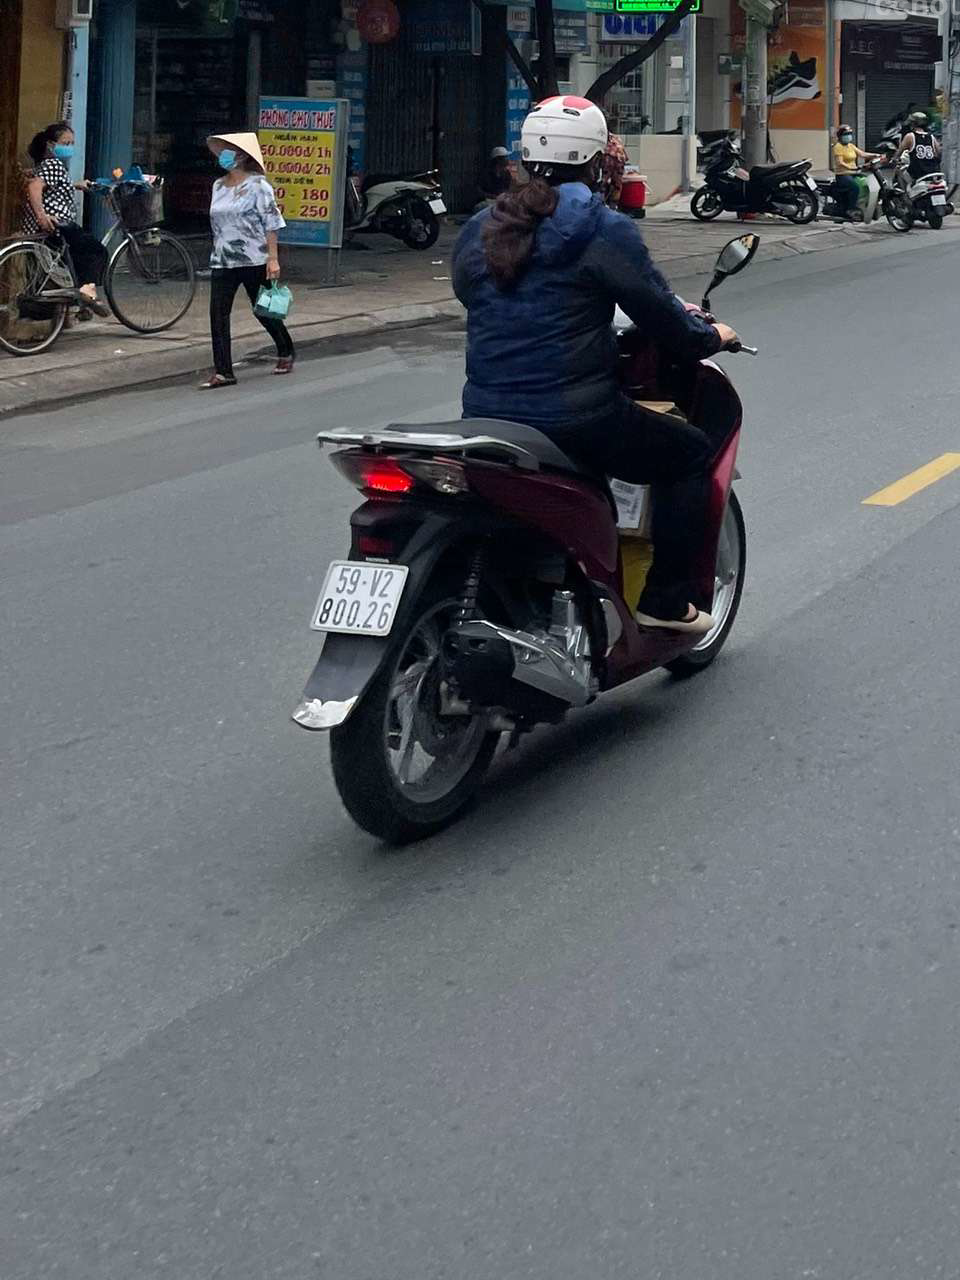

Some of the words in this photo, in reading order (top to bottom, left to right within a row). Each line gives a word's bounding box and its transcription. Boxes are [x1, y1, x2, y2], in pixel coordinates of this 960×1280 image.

[291, 110, 309, 129] CHO
[301, 188, 329, 201] 180
[300, 205, 328, 218] 250
[336, 567, 394, 598] 59-V2
[319, 598, 392, 629] 800.26
